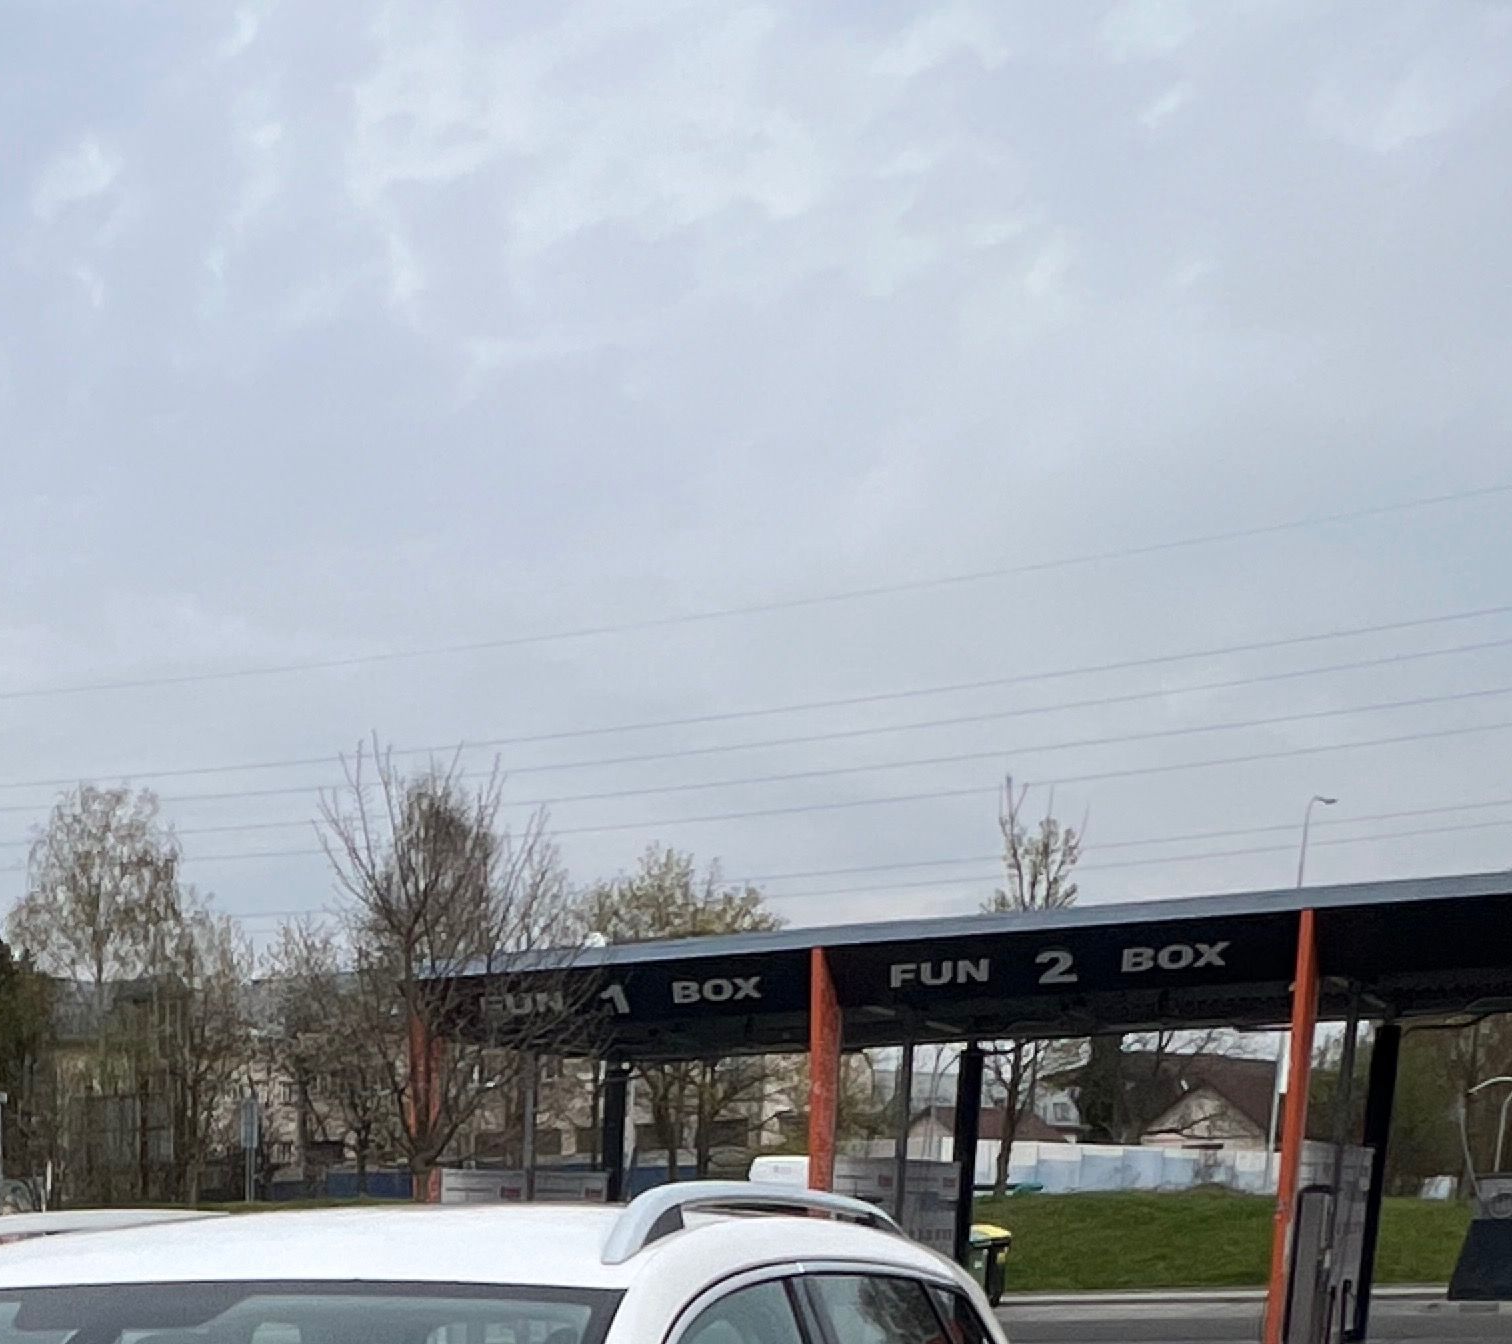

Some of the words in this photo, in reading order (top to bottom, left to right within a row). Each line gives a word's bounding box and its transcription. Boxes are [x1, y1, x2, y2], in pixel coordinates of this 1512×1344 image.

[890, 958, 988, 988] FUN
[1035, 950, 1078, 984] 2
[1121, 941, 1231, 973] BOX
[480, 991, 564, 1016] FUN
[601, 984, 630, 1014] 1
[672, 976, 762, 1004] BOX
